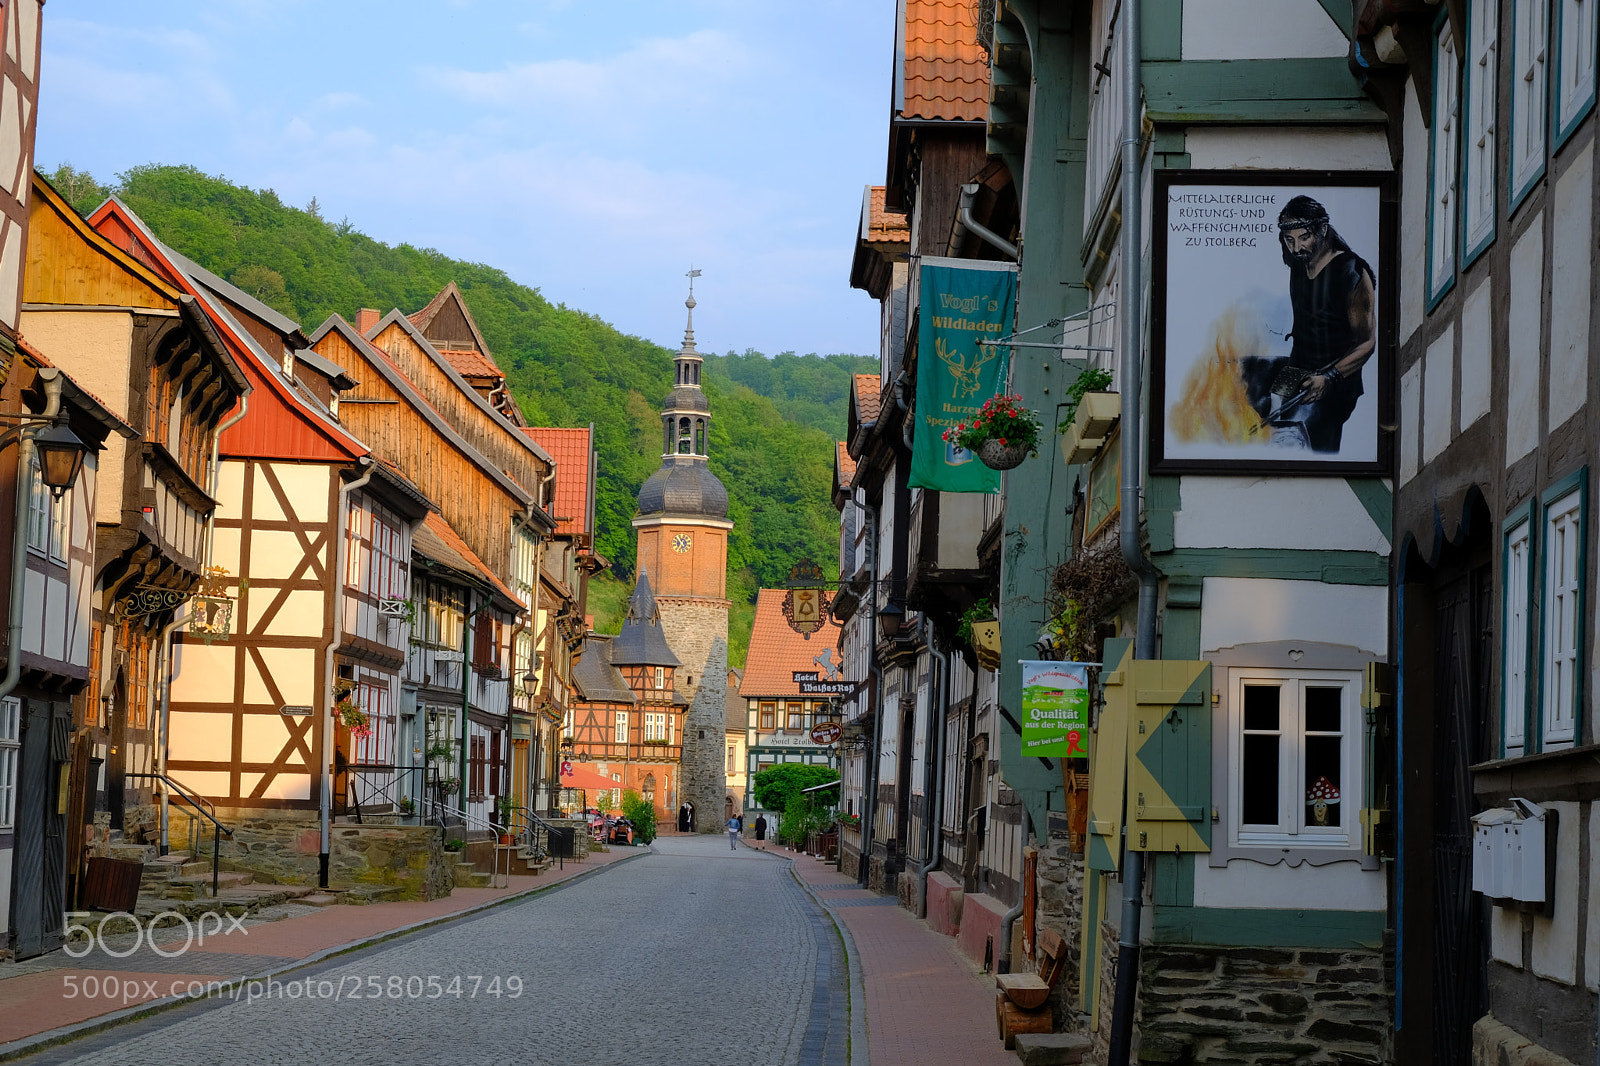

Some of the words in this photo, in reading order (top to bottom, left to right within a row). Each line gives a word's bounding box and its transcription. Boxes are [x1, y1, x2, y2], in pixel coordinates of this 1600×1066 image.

[1168, 194, 1276, 204] MITTELALTERLICHE
[1179, 207, 1238, 218] RÜSTUNGS-
[1241, 209, 1265, 218] UND
[1169, 222, 1274, 233] WAFFENSCHMIEDE
[1185, 237, 1201, 247] ZU
[1204, 237, 1257, 248] STOLBERG
[932, 315, 1003, 332] Wildladen
[794, 674, 817, 682] Hotel
[1030, 708, 1078, 720] Qualität
[1041, 721, 1055, 729] der
[1058, 722, 1086, 730] Region
